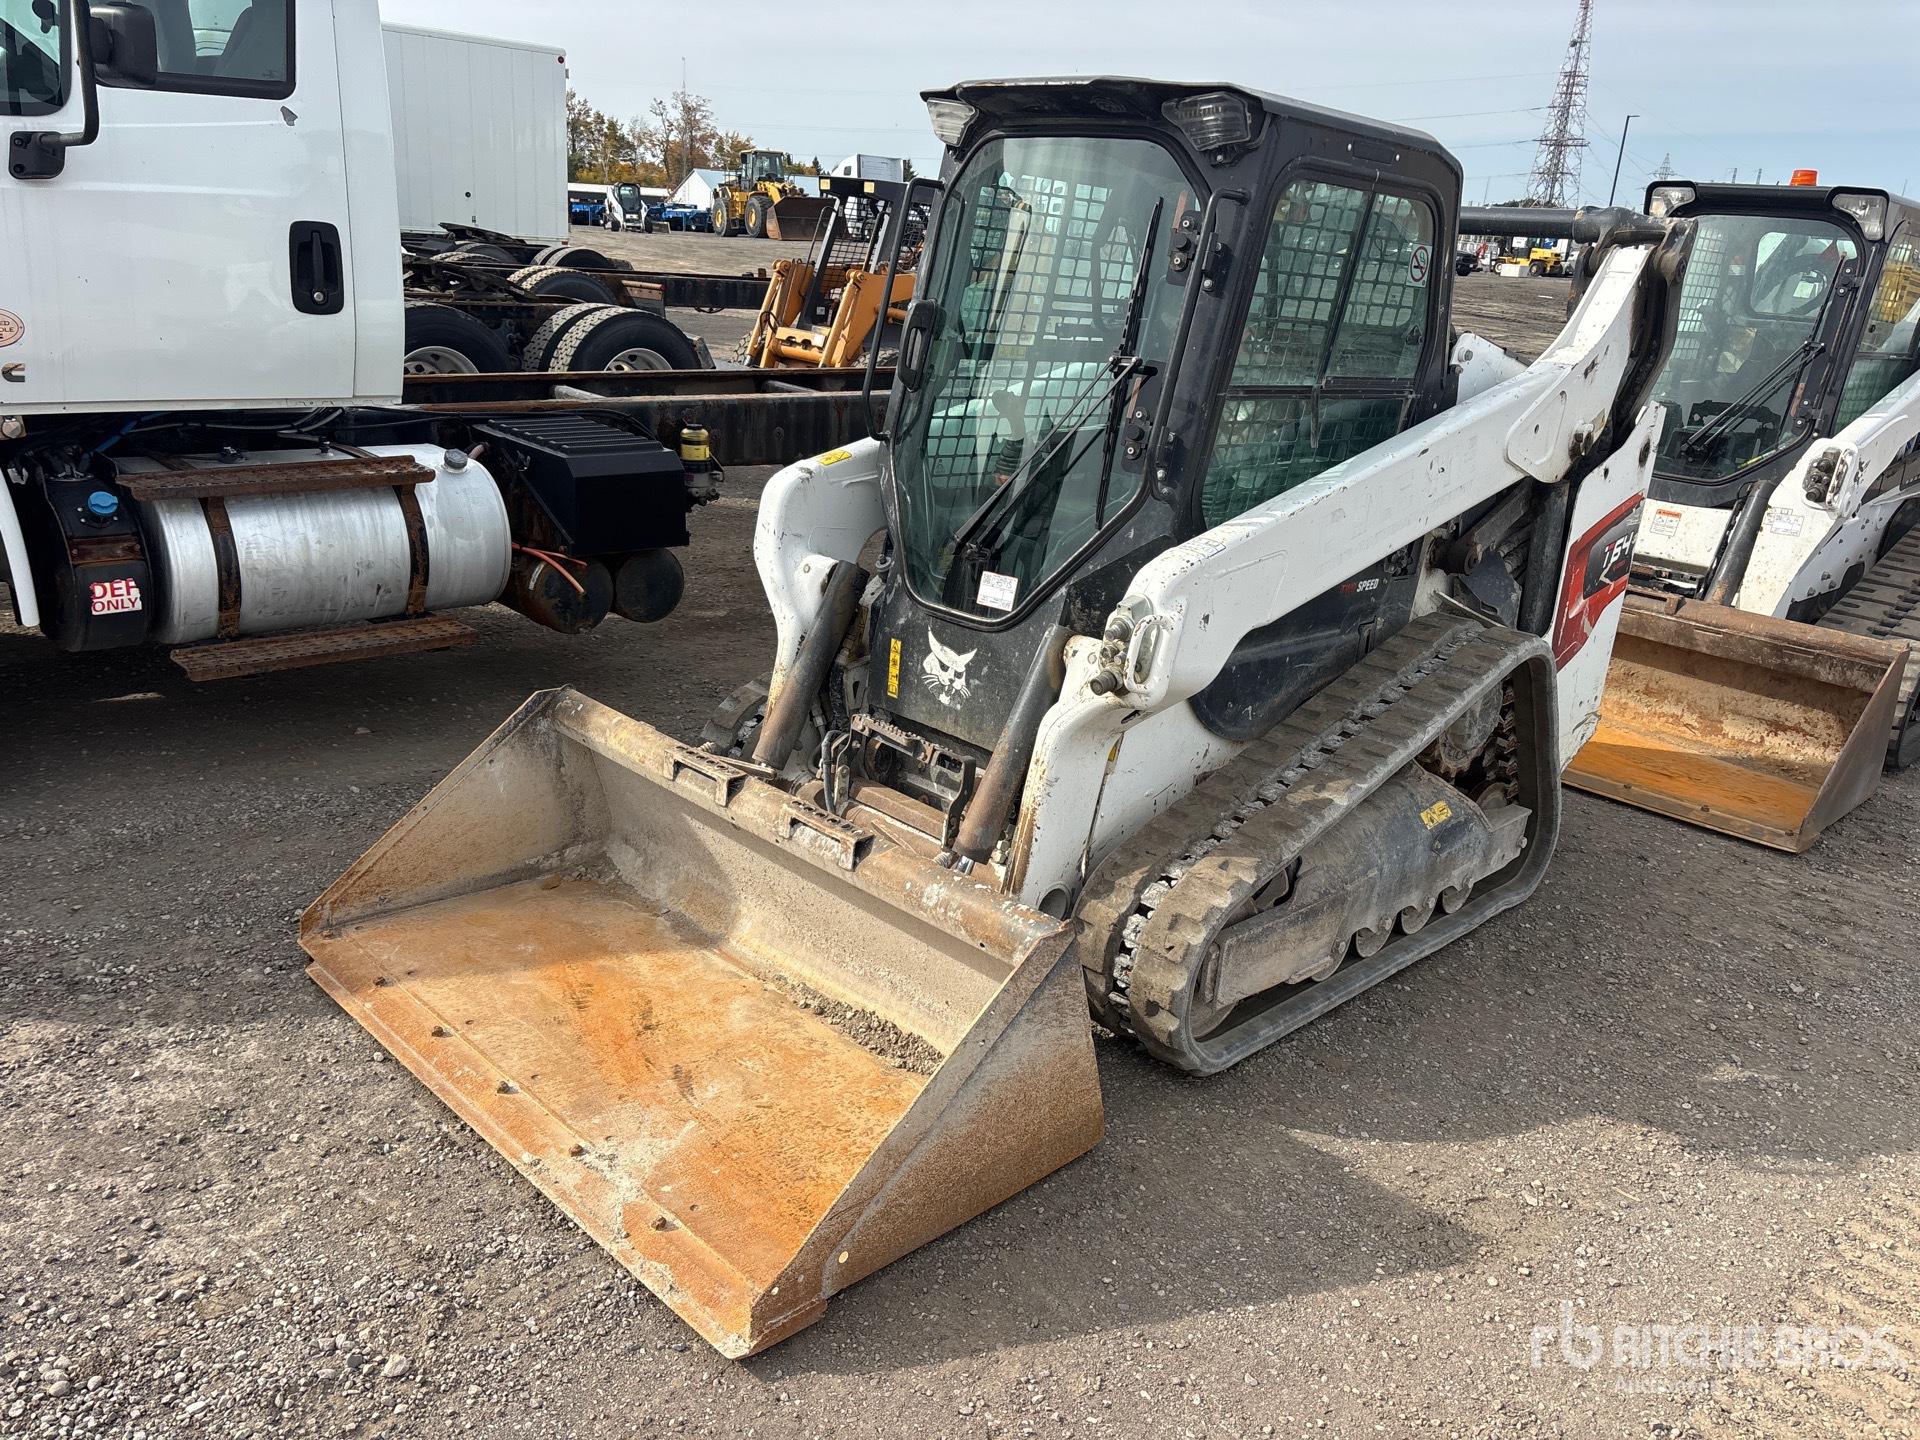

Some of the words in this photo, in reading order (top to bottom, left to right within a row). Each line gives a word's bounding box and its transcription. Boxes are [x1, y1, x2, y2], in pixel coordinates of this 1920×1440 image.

[90, 578, 136, 599] DEF
[1357, 578, 1379, 593] SPEED
[92, 597, 138, 612] ONLY
